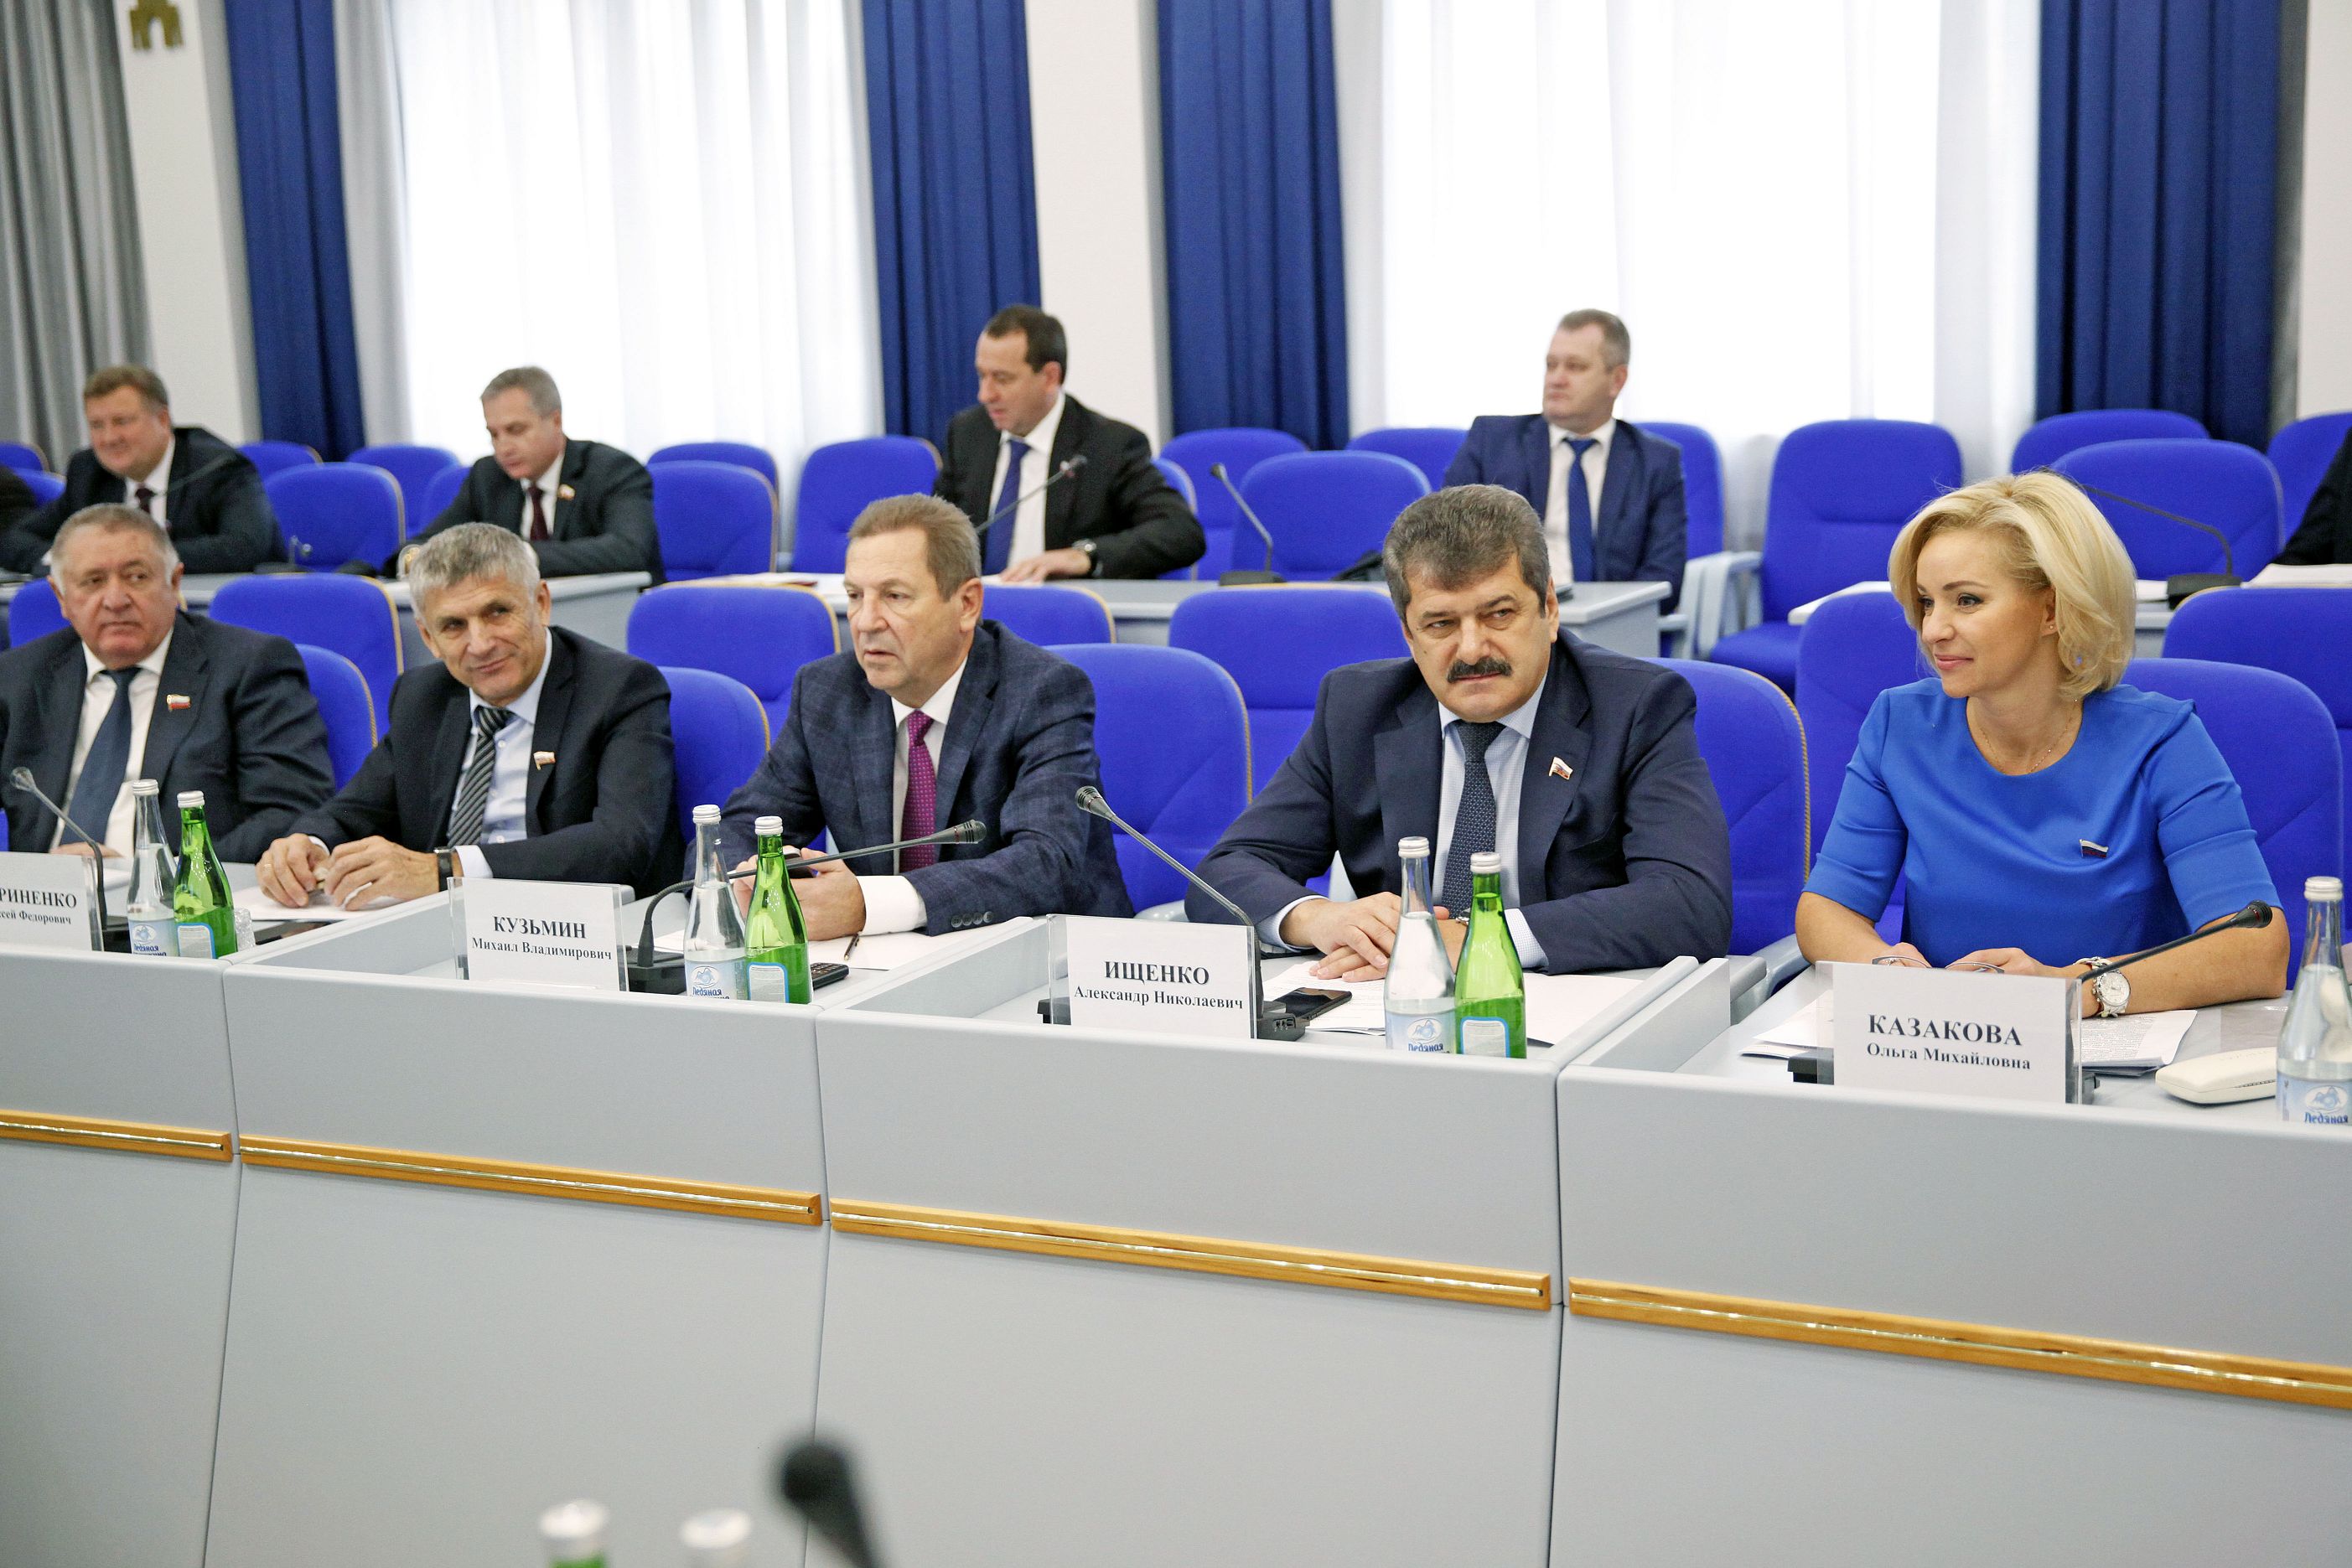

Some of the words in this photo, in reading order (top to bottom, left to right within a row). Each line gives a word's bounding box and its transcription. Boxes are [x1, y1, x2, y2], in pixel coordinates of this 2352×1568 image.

[19, 910, 71, 925] Федорович
[493, 916, 587, 939] КУЗЬМИН
[472, 937, 518, 953] Михаил
[522, 941, 612, 960] Владимирович
[1104, 961, 1210, 986] ИЩЕНКО
[1074, 986, 1149, 1006] Александр
[1154, 991, 1244, 1009] Николаевич
[1868, 1014, 2023, 1047] КАЗАКОВА
[1867, 1042, 1918, 1060] Ольга
[1924, 1047, 2031, 1070] Михайловна
